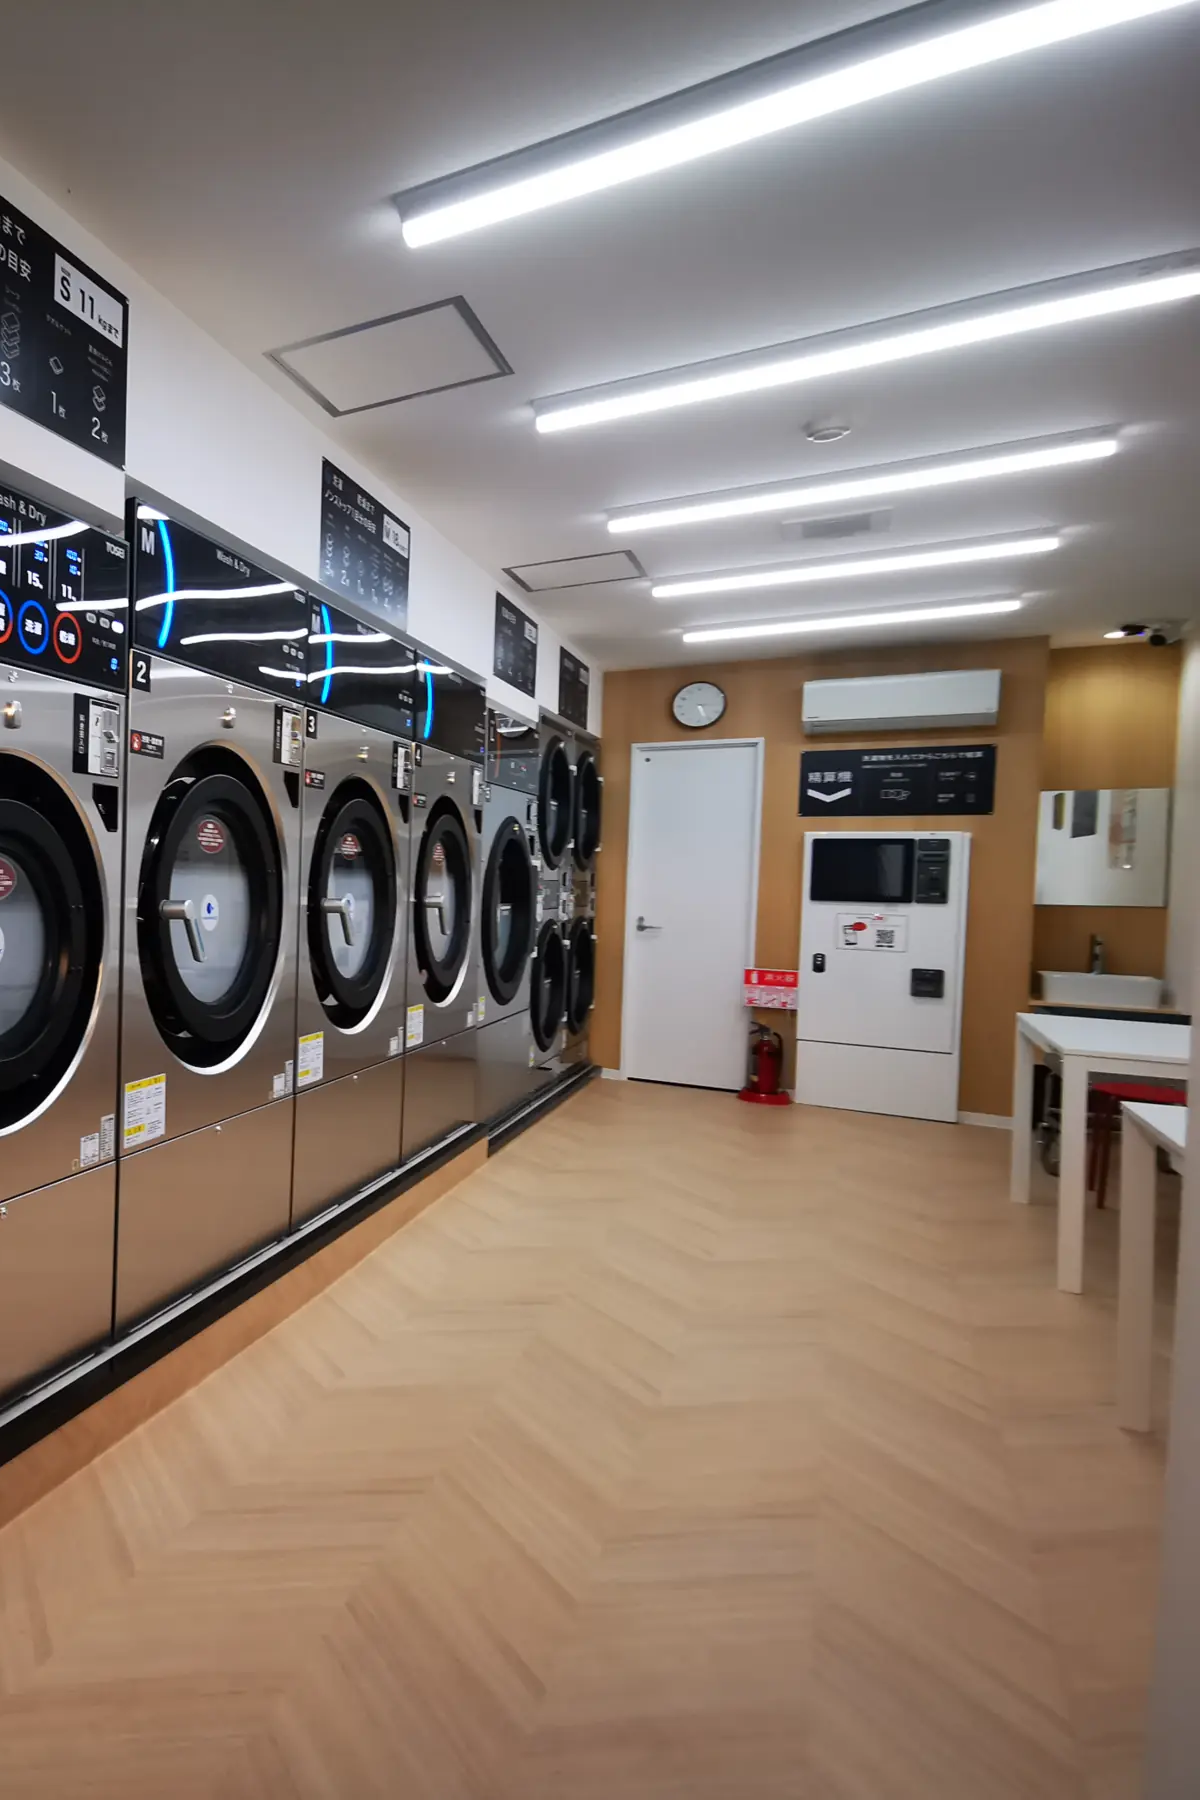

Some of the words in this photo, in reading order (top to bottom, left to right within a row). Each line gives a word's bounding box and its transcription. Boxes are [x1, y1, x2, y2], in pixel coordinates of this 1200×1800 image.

[60, 276, 71, 303] S
[18, 500, 27, 515] &
[28, 503, 47, 527] Dry
[142, 527, 155, 556] M
[136, 661, 147, 683] 2
[308, 715, 316, 733] 3
